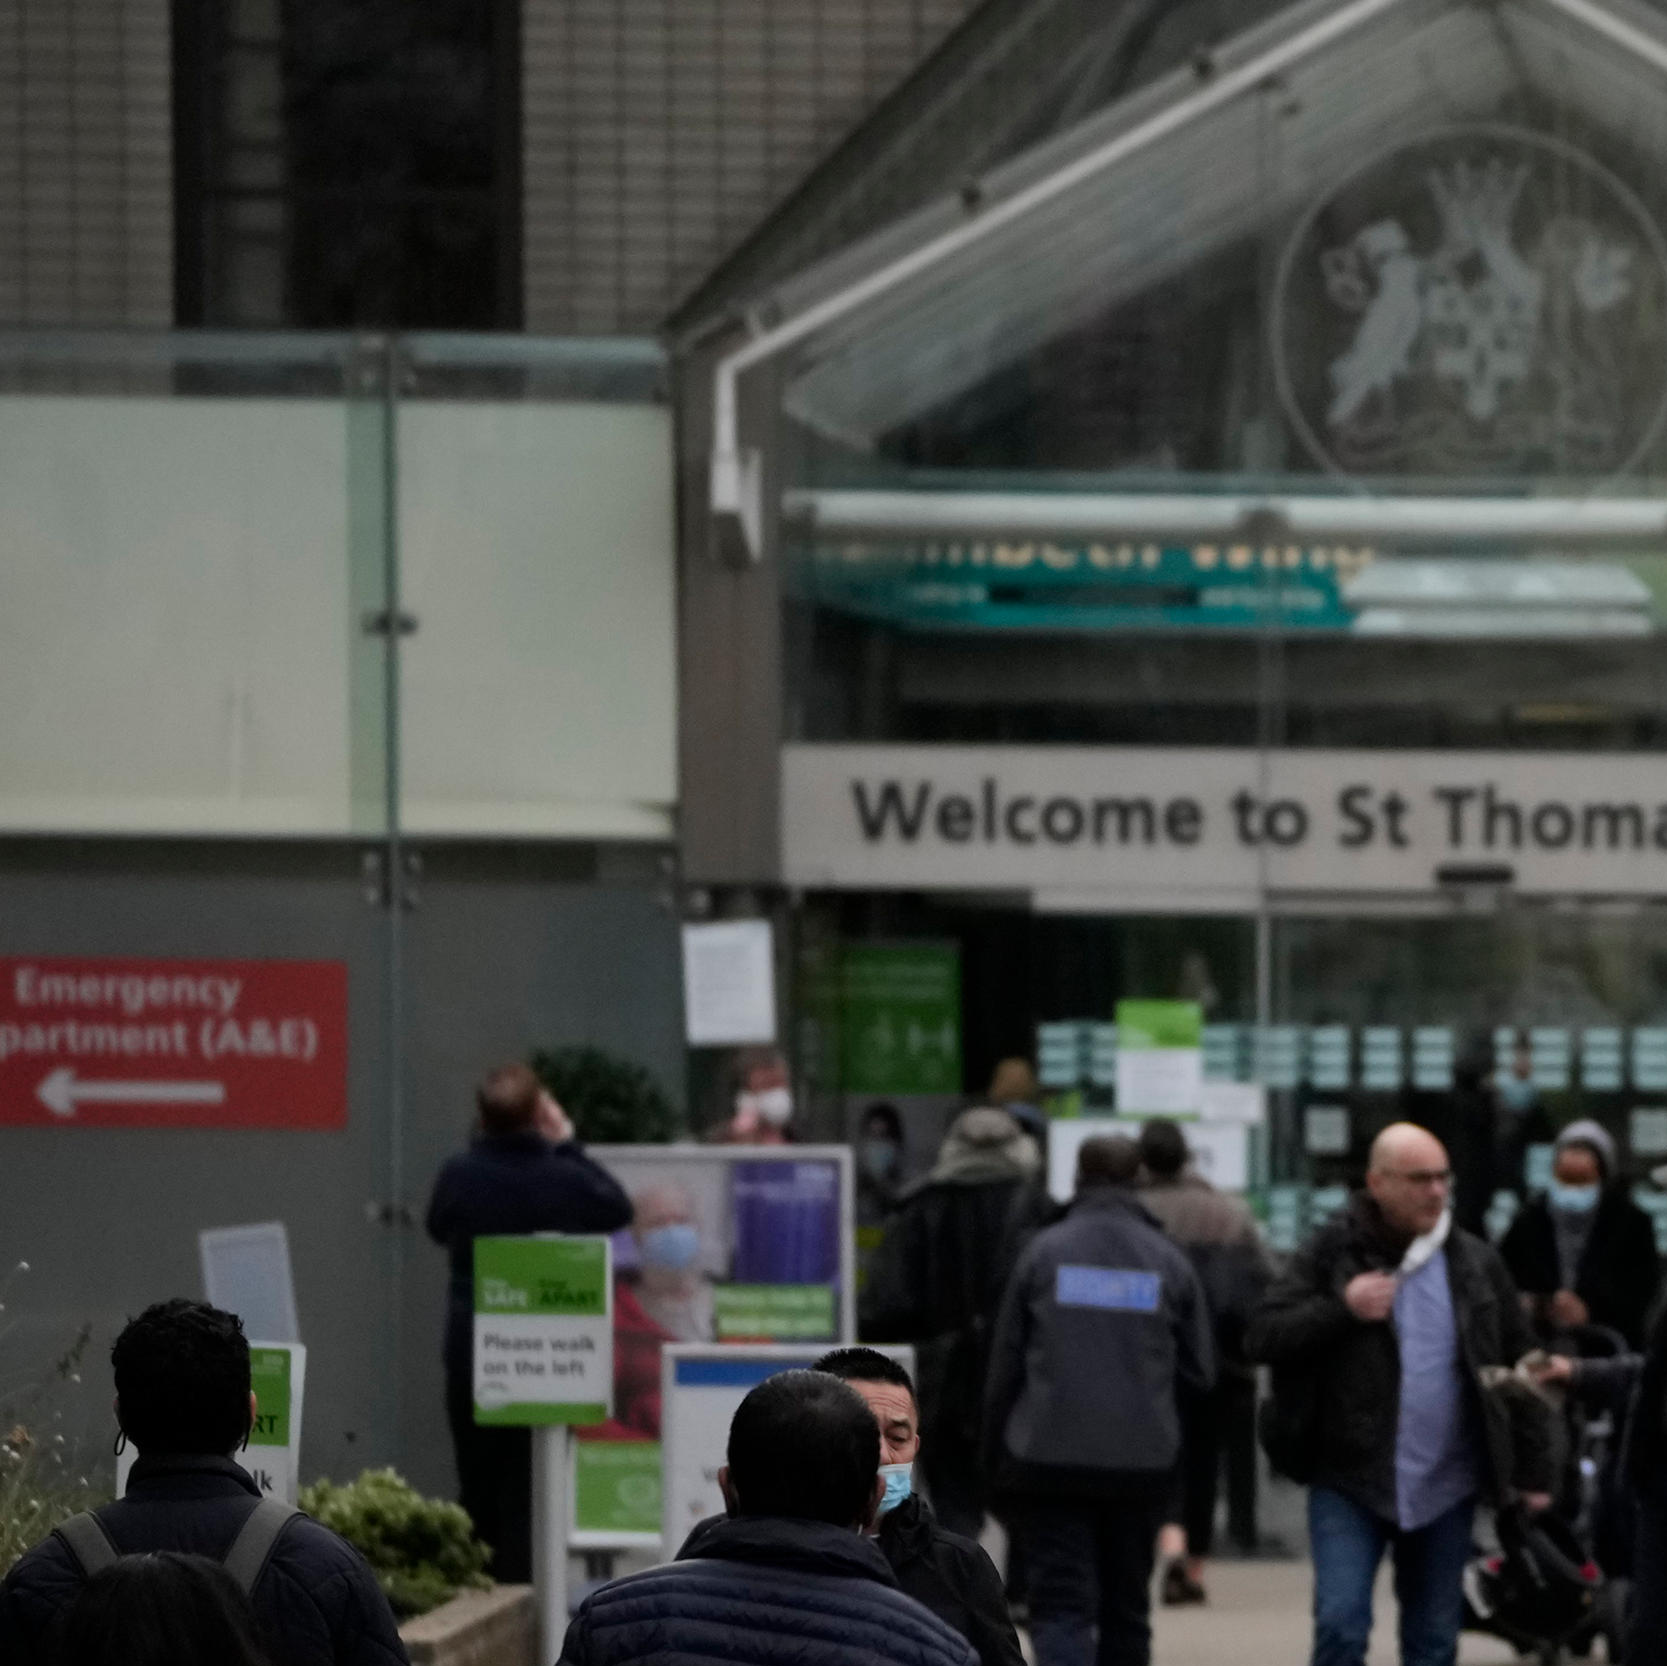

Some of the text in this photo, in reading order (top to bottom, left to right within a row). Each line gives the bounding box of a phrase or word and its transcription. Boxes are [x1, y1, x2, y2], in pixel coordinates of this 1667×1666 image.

[850, 779, 1203, 846] Welcome
[1231, 793, 1310, 848] to
[1337, 785, 1409, 848] St
[14, 966, 241, 1016] Emergency
[200, 1017, 318, 1061] (A&E)
[482, 1331, 596, 1352] Please walk
[482, 1358, 585, 1377] on the left
